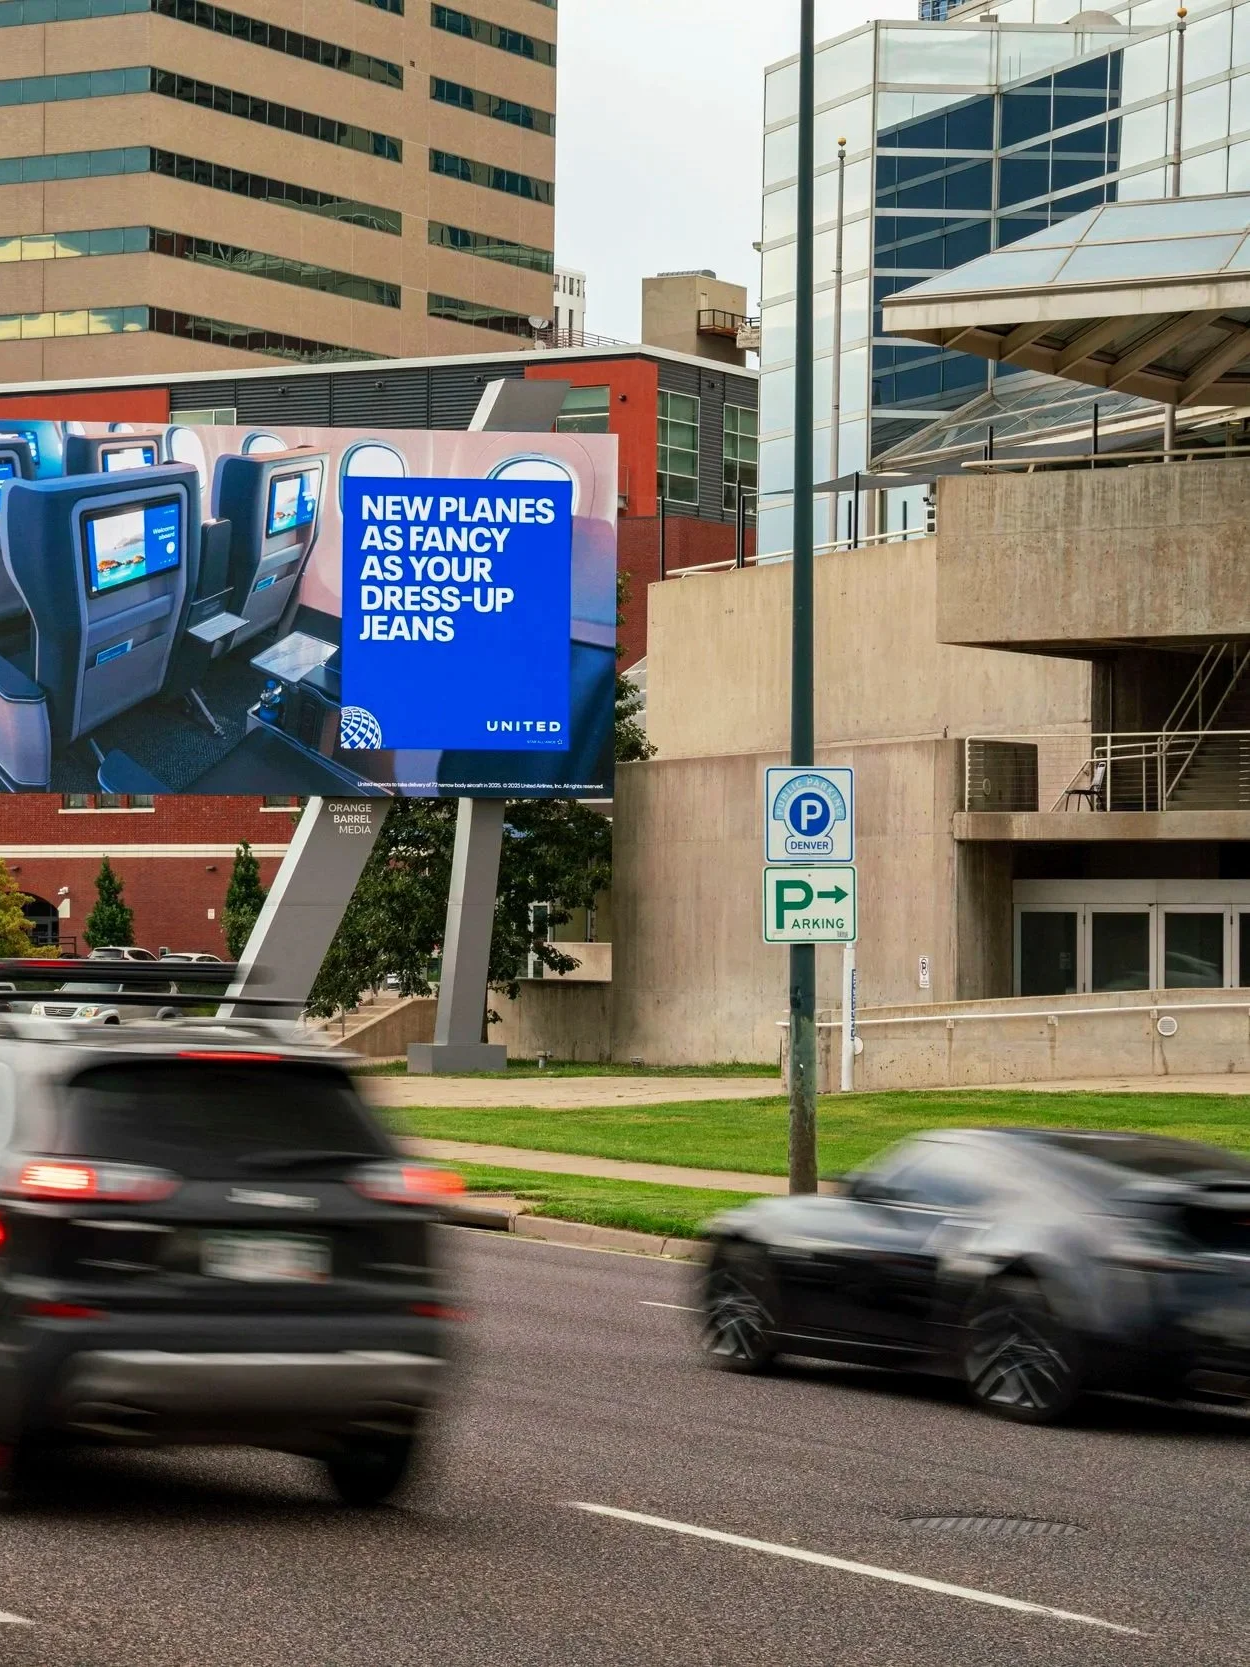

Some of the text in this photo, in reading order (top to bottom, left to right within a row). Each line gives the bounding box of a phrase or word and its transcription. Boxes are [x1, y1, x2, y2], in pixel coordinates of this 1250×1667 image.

[361, 495, 555, 524] NEW PLANES
[360, 525, 510, 553] AS FANCY
[360, 555, 493, 583] AS YOUR
[360, 585, 515, 612] DRESS-UP
[359, 615, 455, 642] JEANS
[486, 720, 562, 733] UNITED
[328, 803, 372, 813] ORANGE
[776, 777, 844, 816] PUBLIC PARKING
[333, 814, 372, 824] BARREL
[800, 799, 823, 831] P
[339, 825, 372, 834] MEDIA
[790, 841, 829, 850] DENVER
